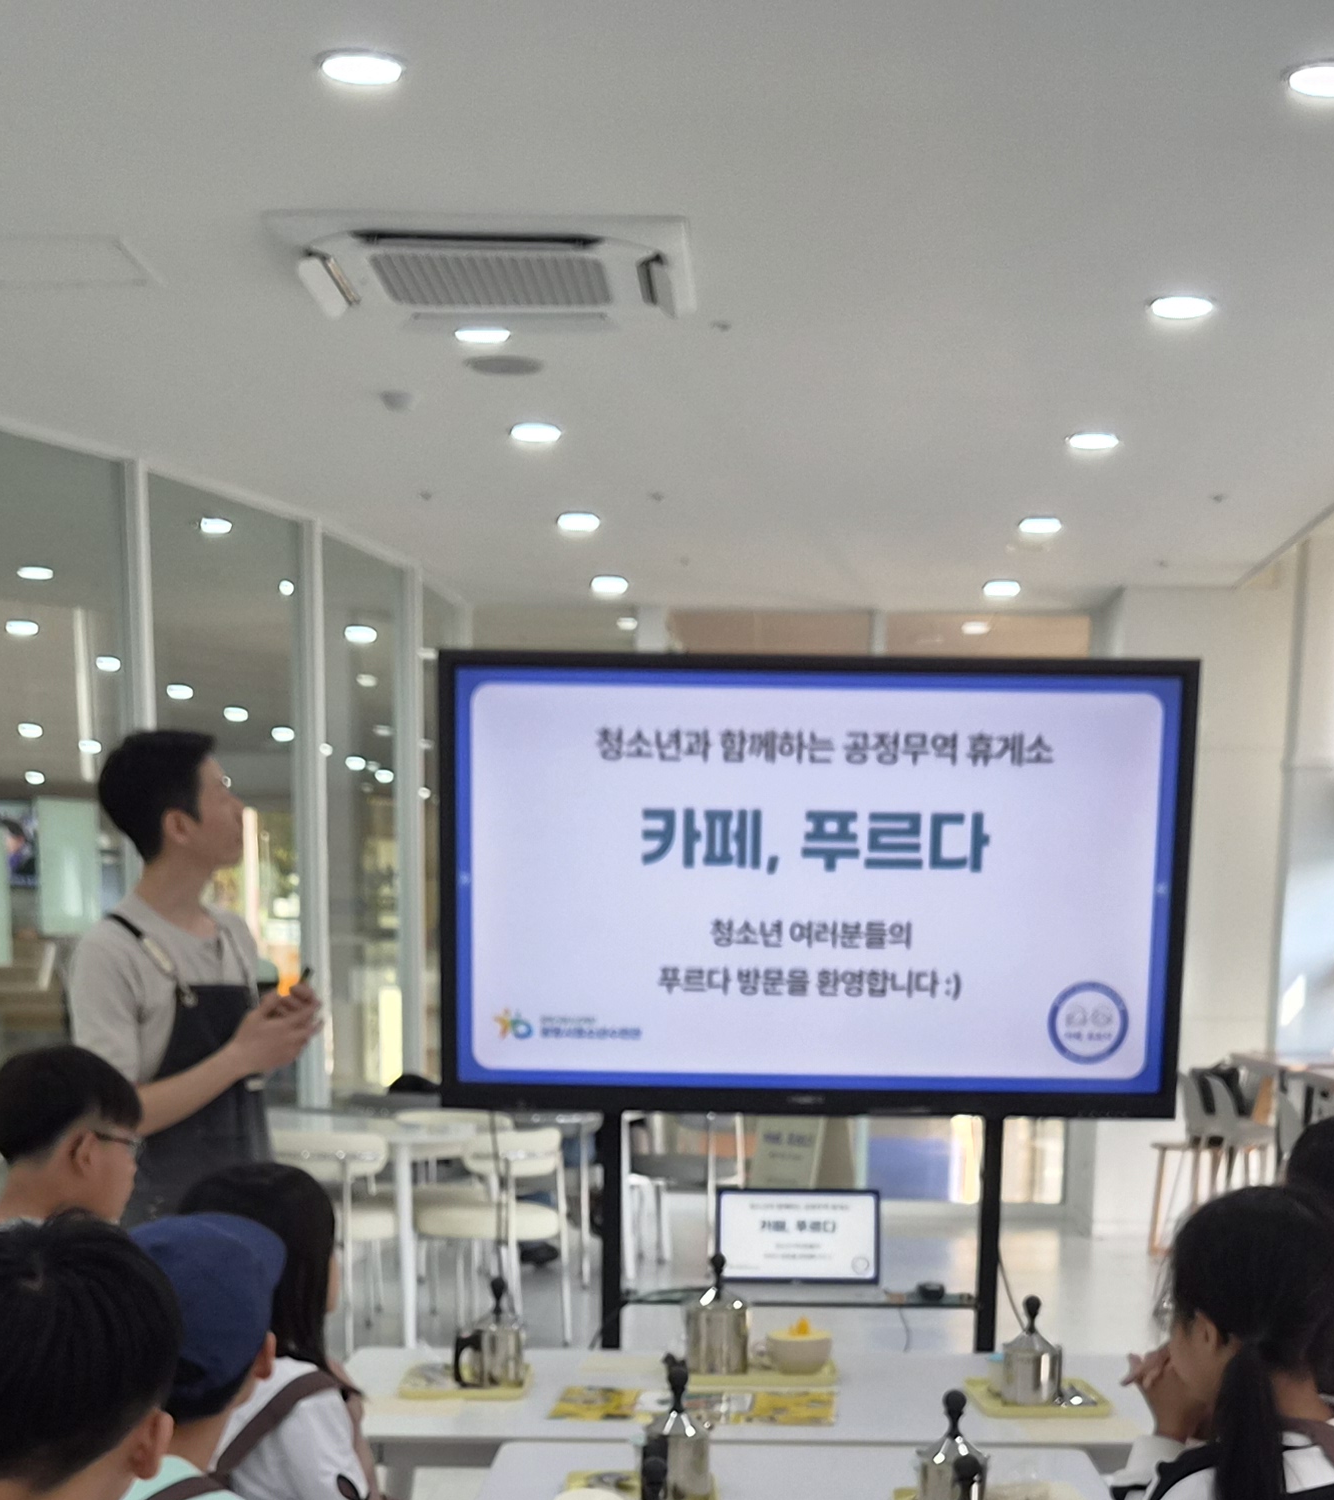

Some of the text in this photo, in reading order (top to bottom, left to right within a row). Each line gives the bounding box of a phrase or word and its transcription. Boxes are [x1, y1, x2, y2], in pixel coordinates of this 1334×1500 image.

[596, 726, 1055, 767] 청소년과 함께하는 공정무역 휴게소
[641, 808, 990, 875] 카페, 푸르다
[711, 918, 913, 950] 청소년 여러분들의
[656, 966, 730, 995] 푸르다
[737, 967, 809, 996] 방문을
[816, 968, 939, 999] 환영합니다
